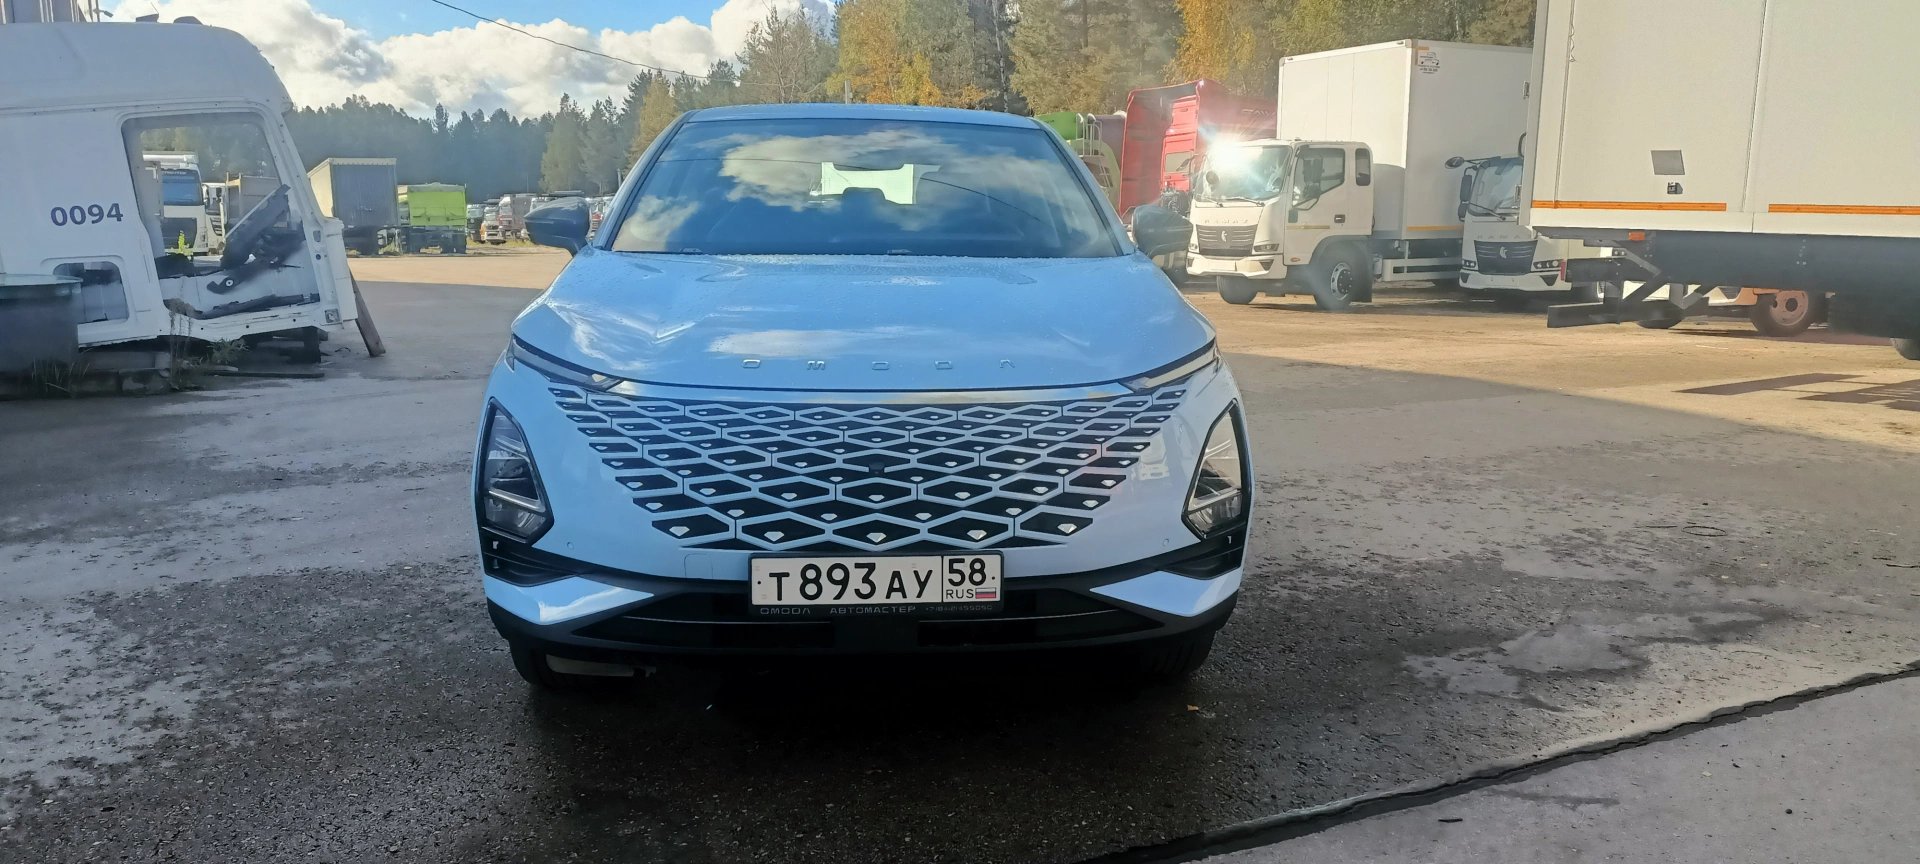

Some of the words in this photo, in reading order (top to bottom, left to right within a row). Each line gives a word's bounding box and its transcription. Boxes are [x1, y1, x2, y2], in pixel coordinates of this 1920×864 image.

[51, 203, 123, 226] 0094
[742, 359, 1016, 371] OMODA
[948, 557, 987, 587] 58
[945, 588, 975, 600] RUS
[760, 607, 811, 615] OMODA
[830, 605, 916, 615] АВТОМАСТЕР
